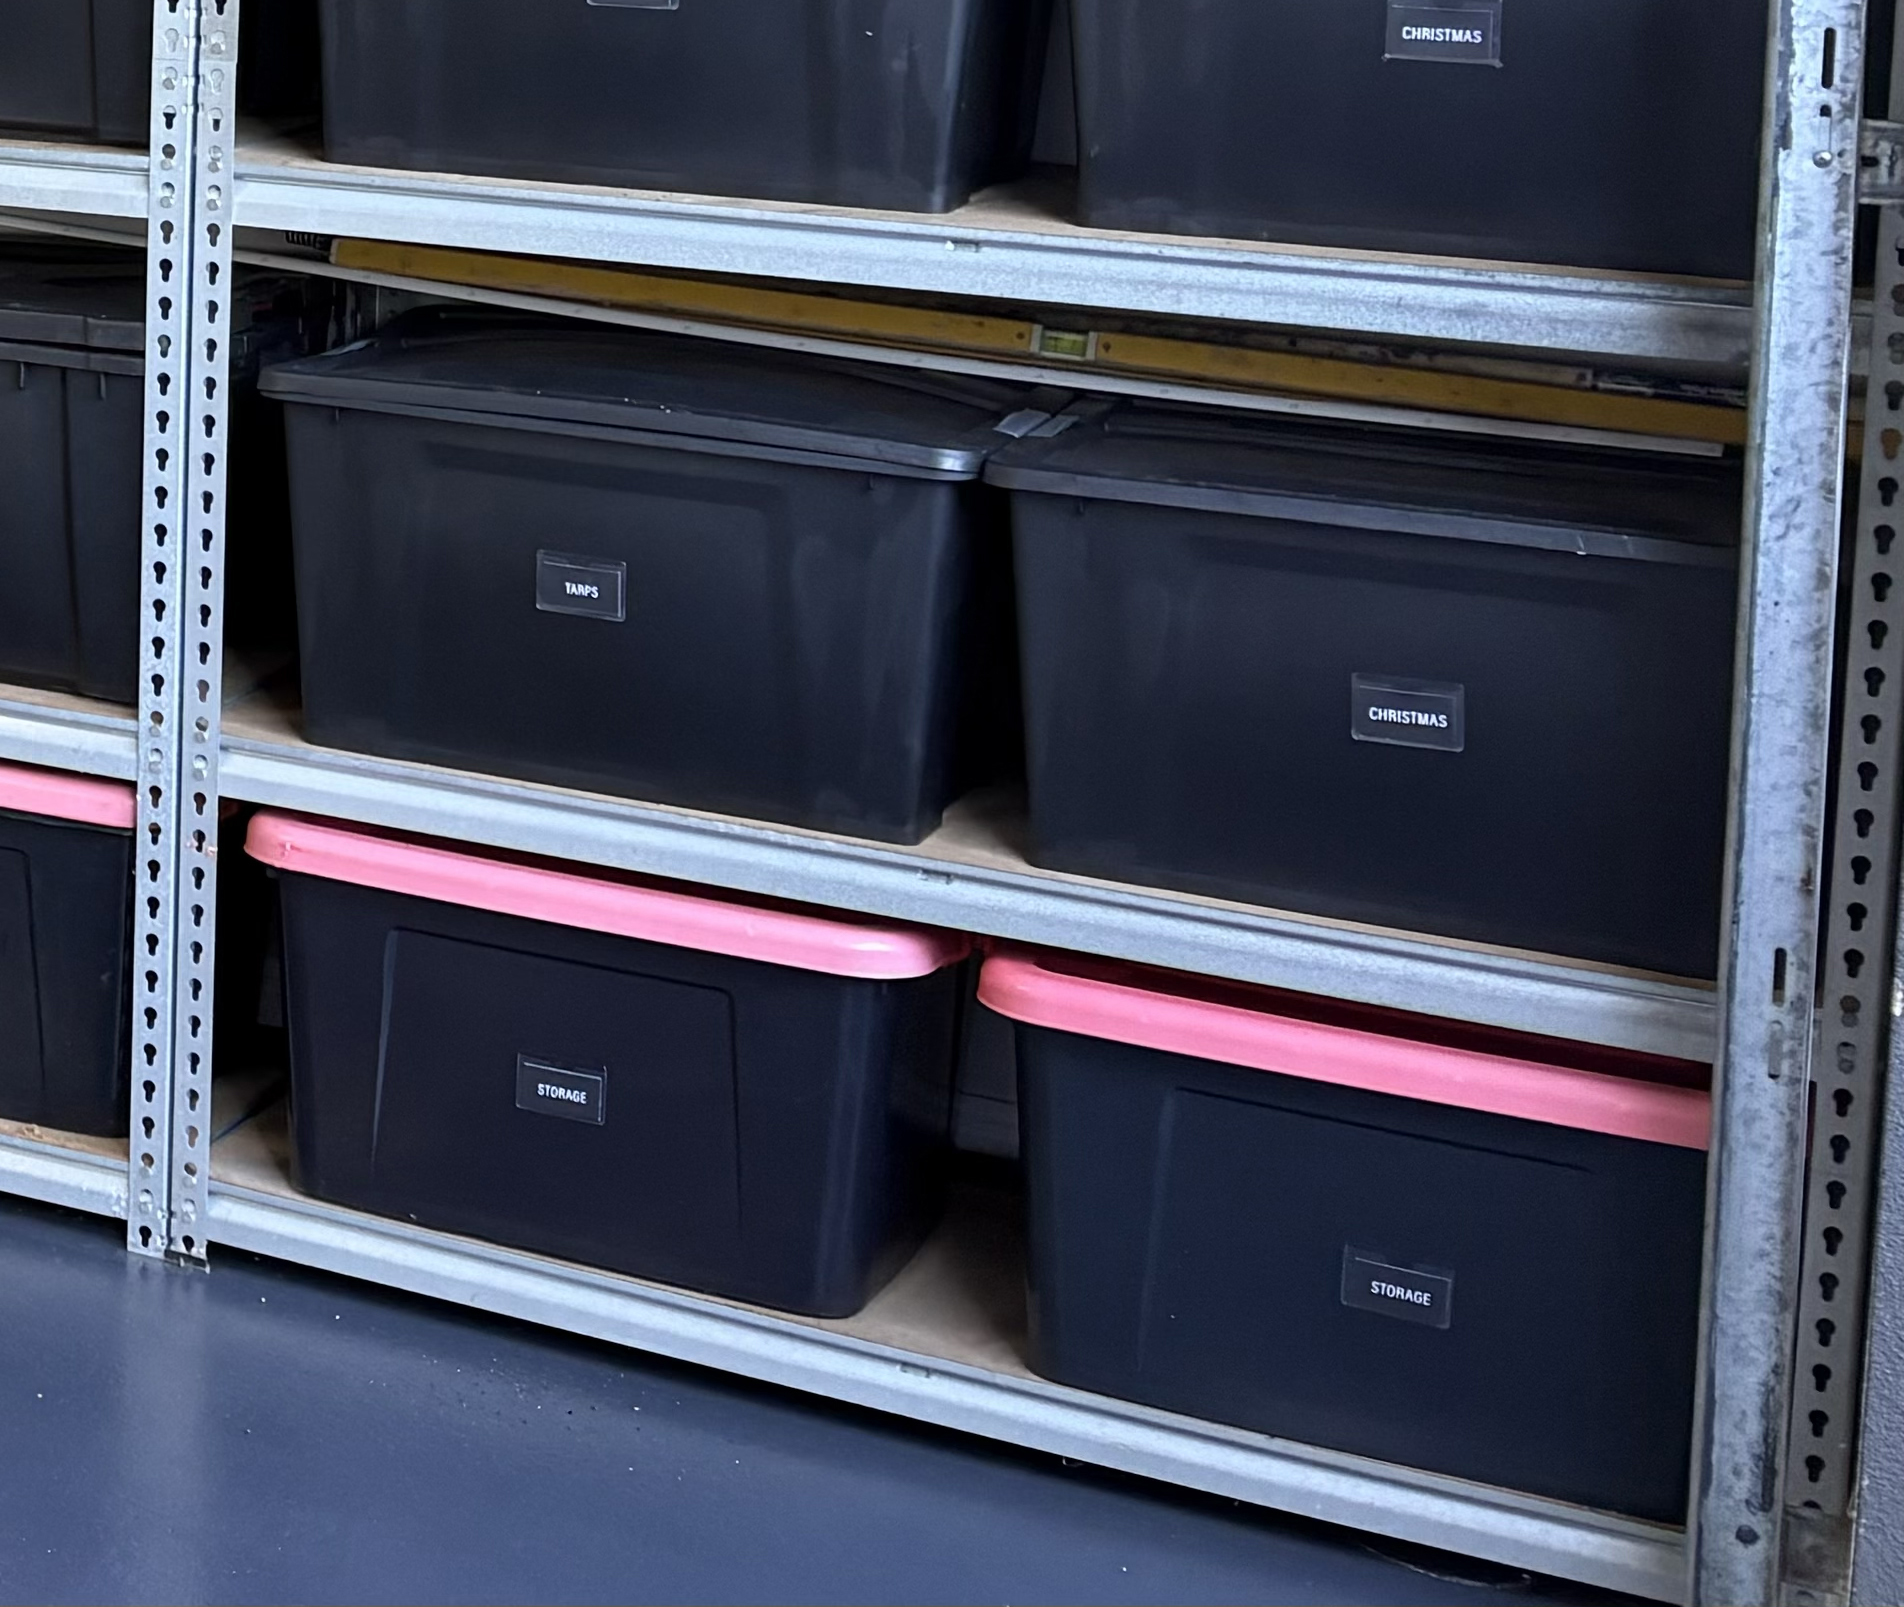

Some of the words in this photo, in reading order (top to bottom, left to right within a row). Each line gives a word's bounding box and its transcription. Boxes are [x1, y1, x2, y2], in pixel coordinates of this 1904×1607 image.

[1402, 27, 1482, 44] CHRISTMAS
[565, 582, 598, 599] TARPS
[1369, 707, 1447, 727] CHRISTMAS
[538, 1084, 587, 1104] STORAGE
[1370, 1281, 1432, 1305] STORAGE
